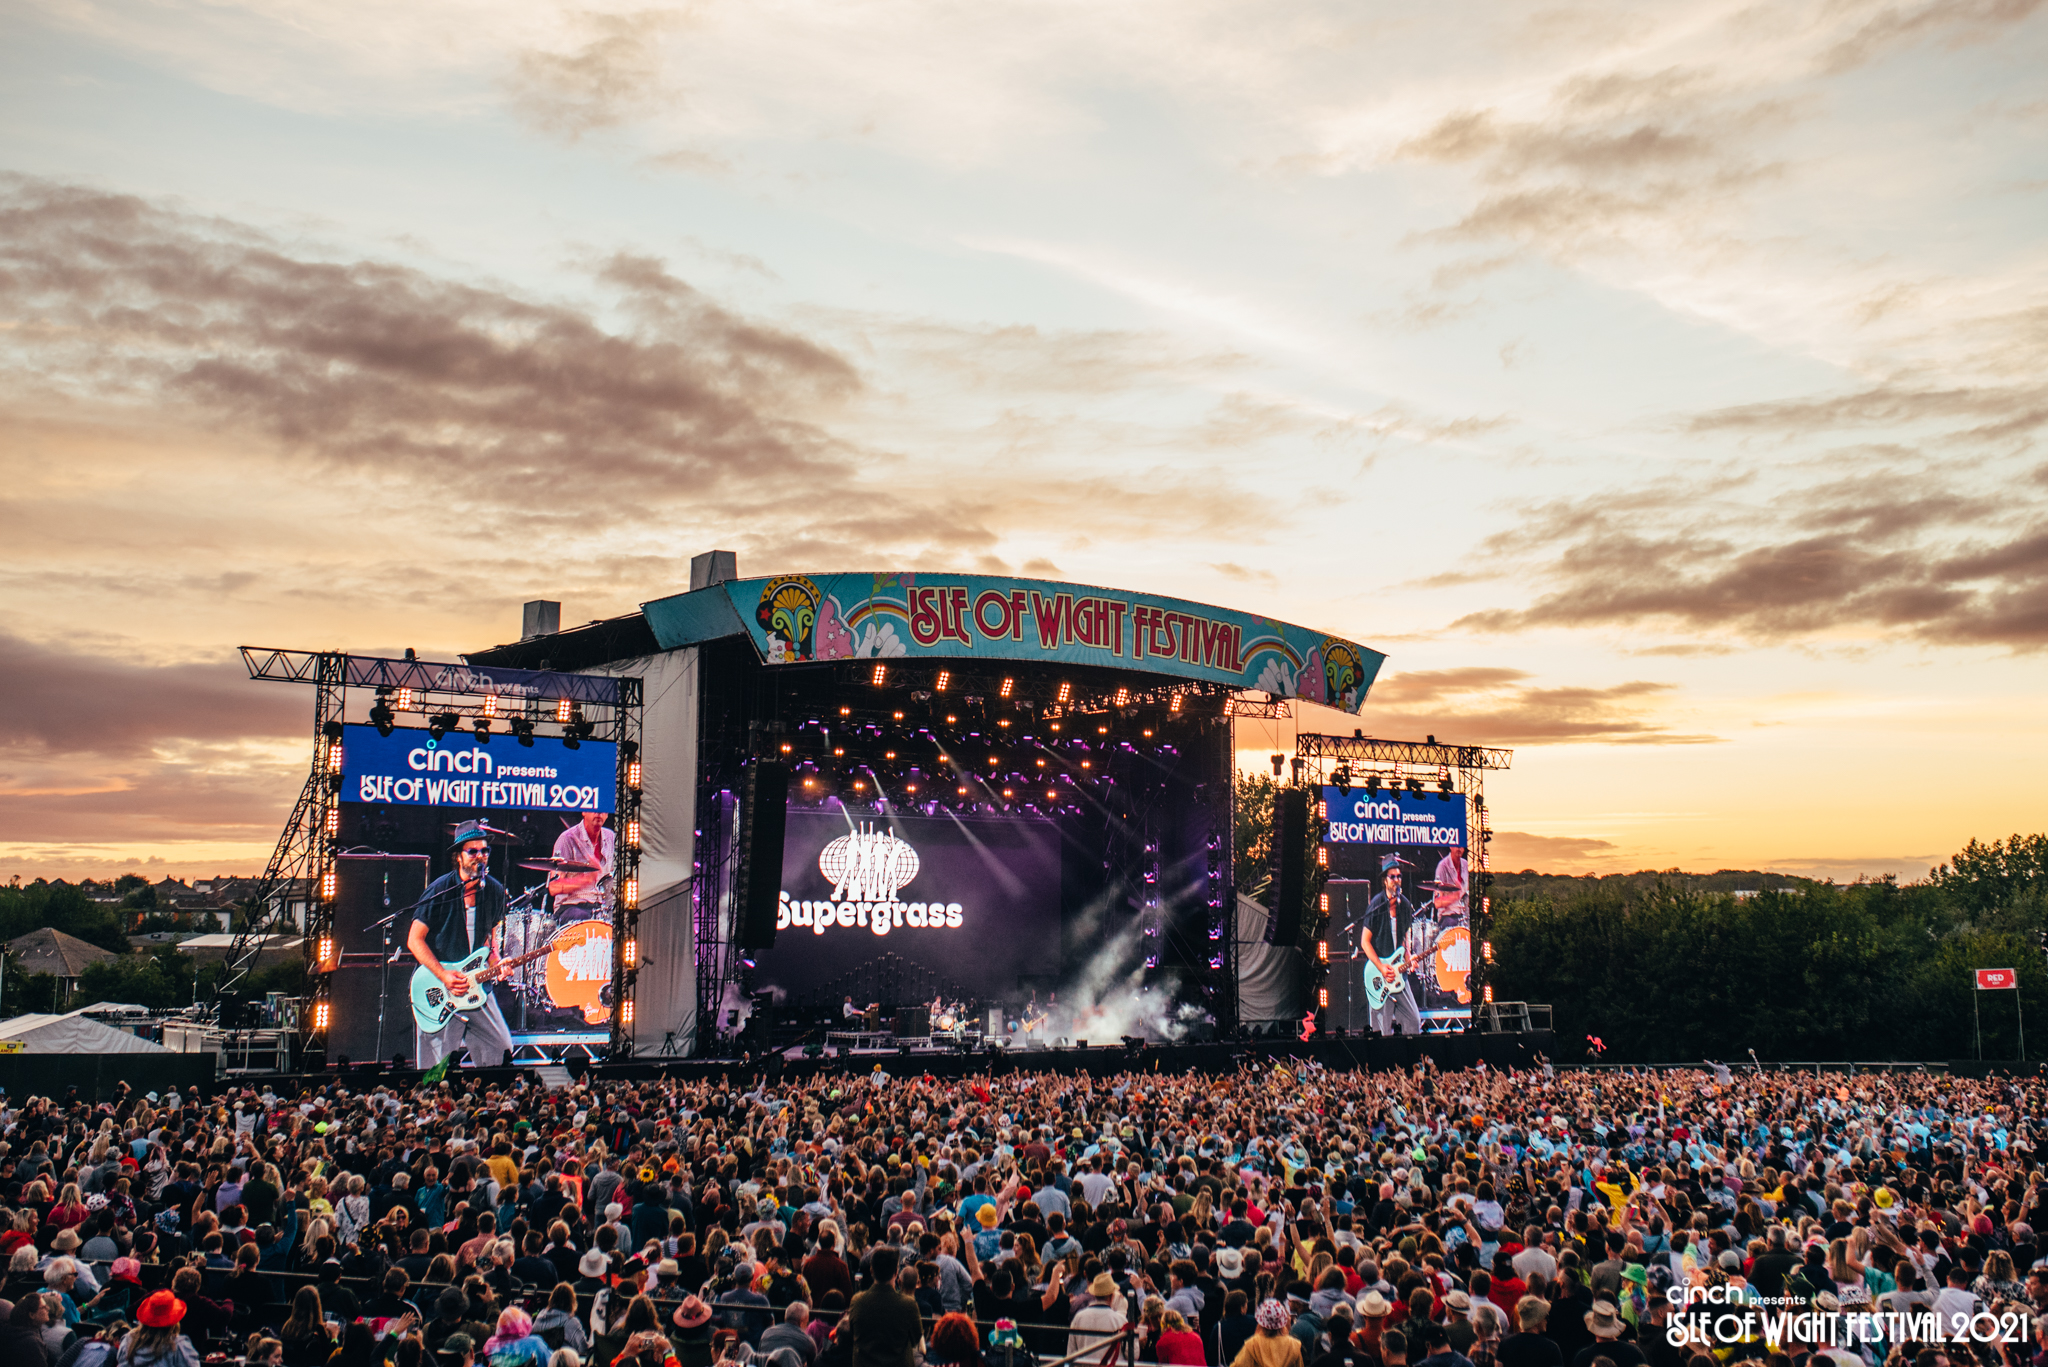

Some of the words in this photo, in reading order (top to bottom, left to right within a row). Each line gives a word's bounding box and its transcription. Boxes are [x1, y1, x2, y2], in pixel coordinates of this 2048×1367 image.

[907, 586, 972, 648] ISLE
[973, 588, 1031, 641] OF
[1030, 590, 1128, 658] WIGHT
[1131, 603, 1245, 675] FESTIVAL
[408, 739, 492, 774] cinch
[497, 765, 557, 779] presents
[360, 775, 392, 802] ISLE
[393, 778, 423, 801] OF
[425, 778, 480, 807] WIGHT
[481, 781, 548, 807] FESTIVAL
[549, 784, 599, 809] 2021
[1354, 794, 1400, 820] cinch
[1402, 812, 1436, 823] presents
[1330, 822, 1348, 842] ISLE
[1347, 823, 1364, 841] OF
[1364, 823, 1394, 844] WIGHT
[1394, 826, 1431, 844] FESTIVAL
[1431, 827, 1459, 845] 2021
[1987, 974, 2004, 982] RED
